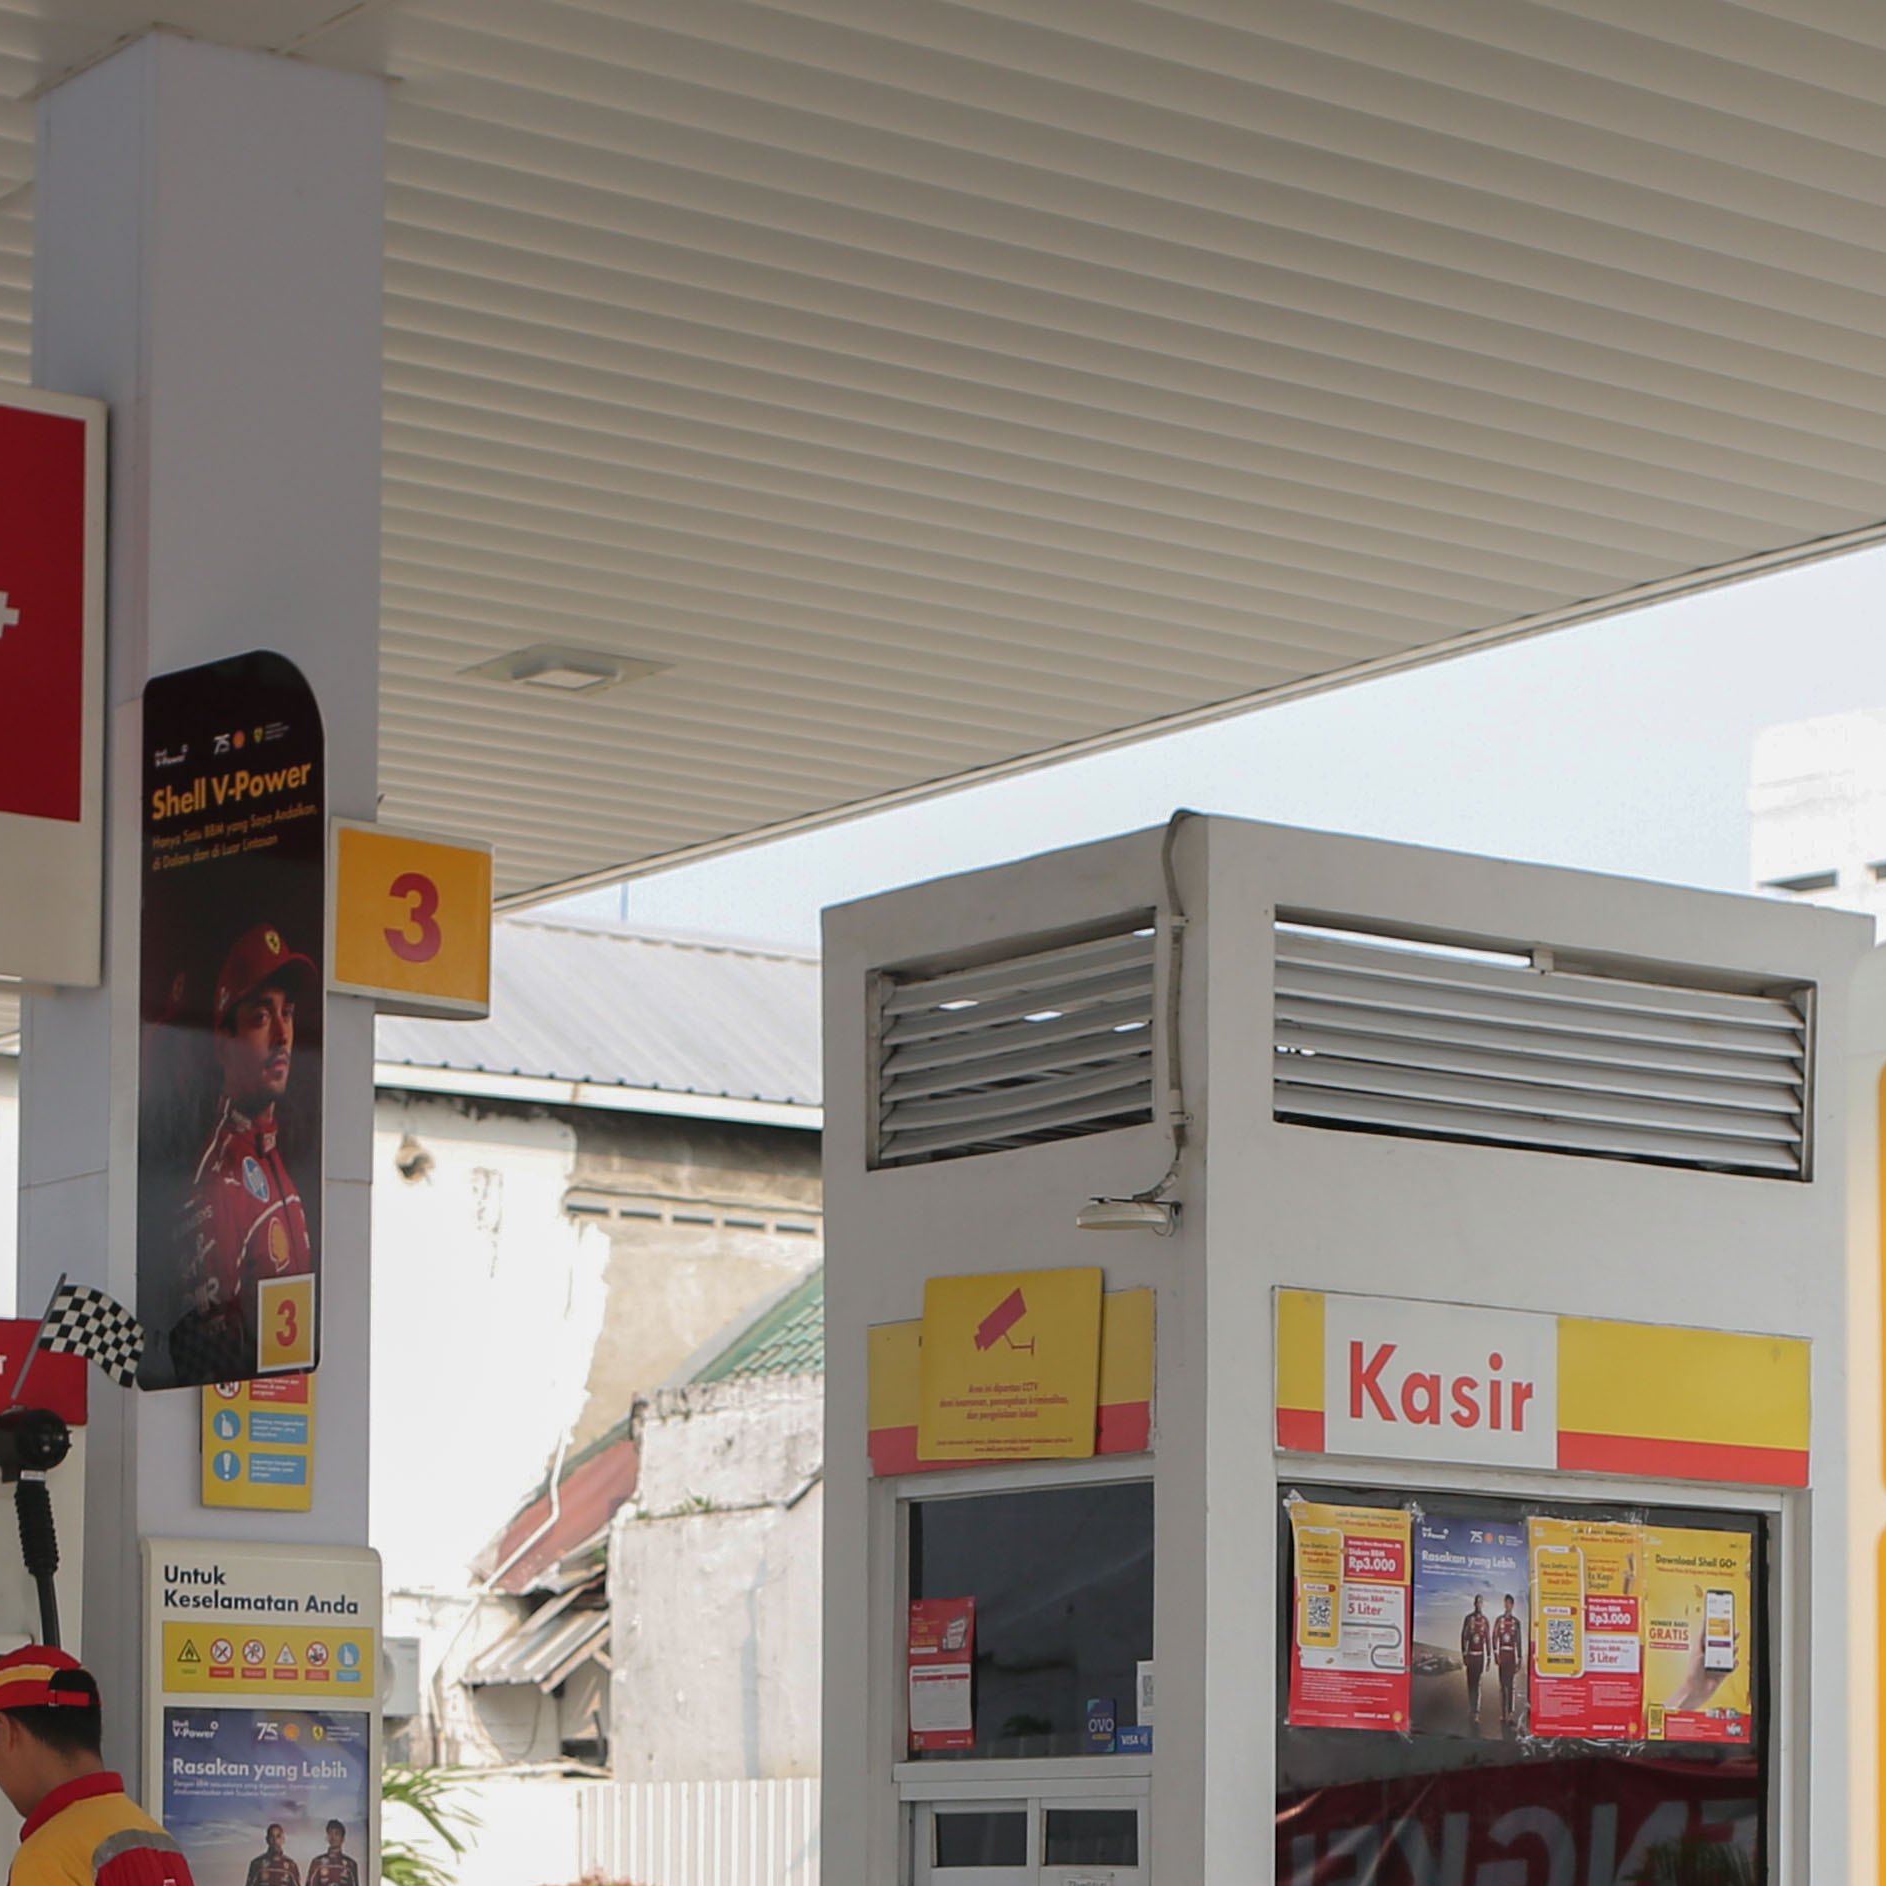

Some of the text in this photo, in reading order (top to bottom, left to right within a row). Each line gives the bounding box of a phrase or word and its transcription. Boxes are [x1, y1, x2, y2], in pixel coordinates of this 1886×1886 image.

[152, 763, 311, 819] Shell V-Power
[384, 873, 441, 962] 3
[275, 1300, 297, 1347] 3
[1349, 1341, 1533, 1432] Kasir
[1348, 1556, 1396, 1572] Rp3.000
[165, 1565, 225, 1586] Untuk
[165, 1589, 358, 1614] Keselamatan Anda
[1347, 1603, 1382, 1615] 5 Liter
[1649, 1628, 1689, 1640] GRATIS
[1589, 1653, 1619, 1664] 5 Liter
[1088, 1718, 1114, 1732] OVO
[1121, 1733, 1139, 1746] VISA
[173, 1758, 348, 1780] Rasakan yang Lebih
